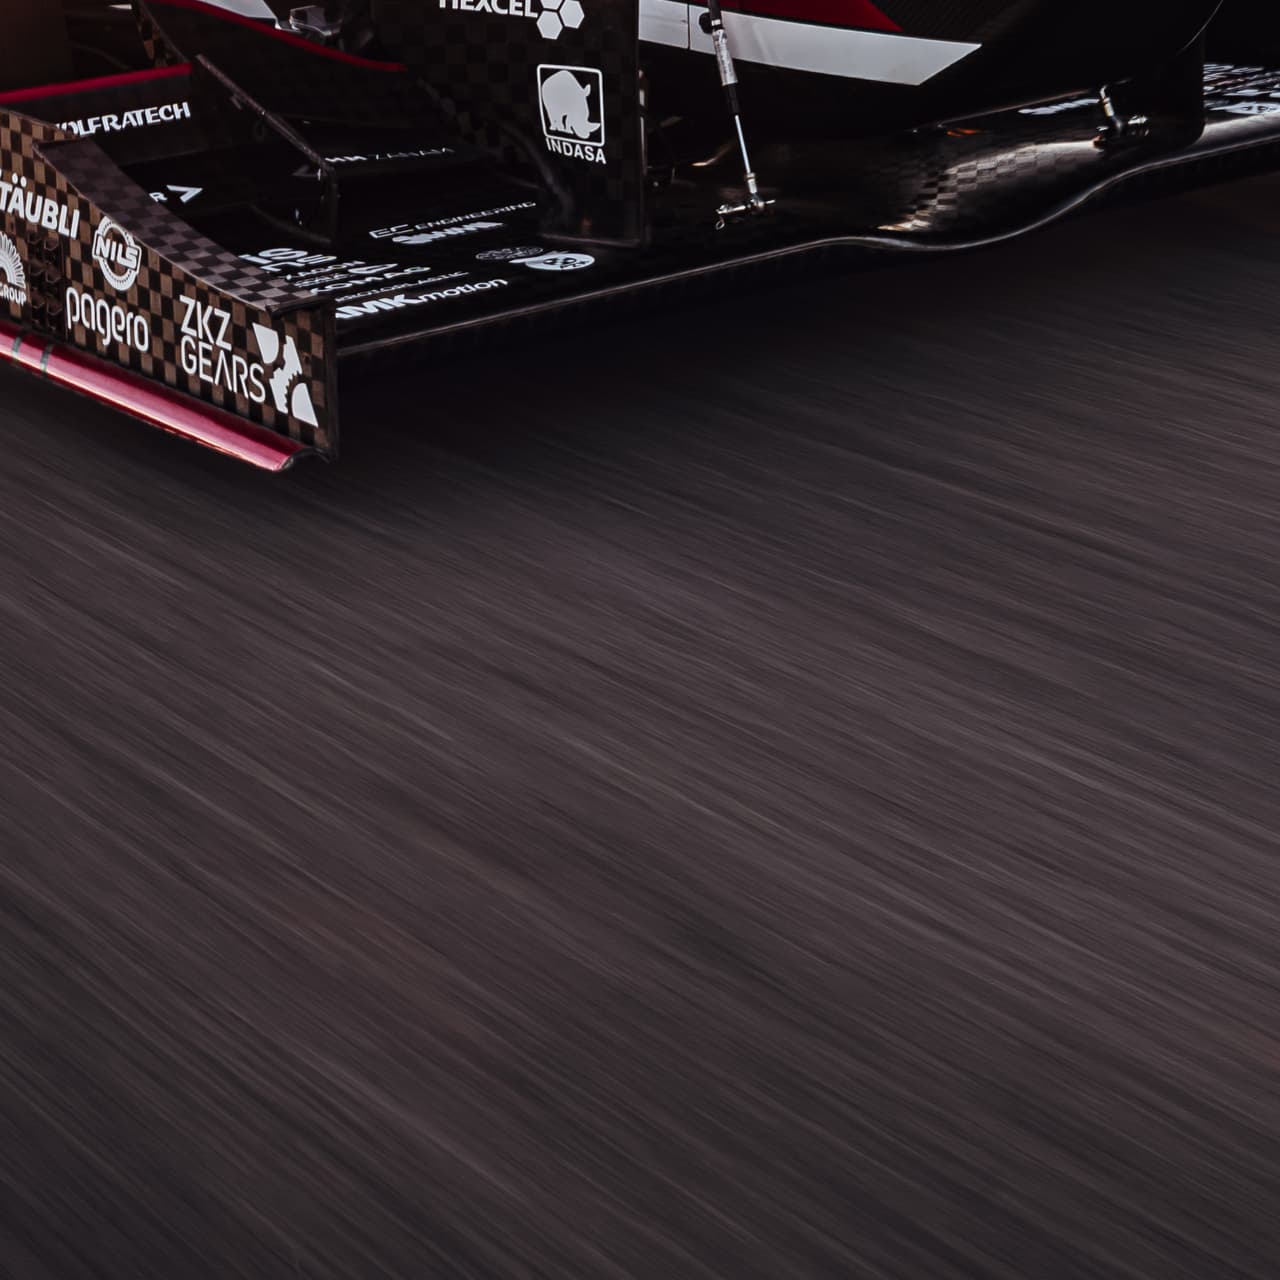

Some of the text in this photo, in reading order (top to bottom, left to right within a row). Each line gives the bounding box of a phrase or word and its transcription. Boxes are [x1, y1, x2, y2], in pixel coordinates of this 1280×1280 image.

[546, 136, 606, 165] INDASA
[94, 236, 140, 270] NILS
[66, 287, 149, 352] pagero
[179, 294, 233, 351] ZKZ
[180, 335, 266, 403] GEARS
